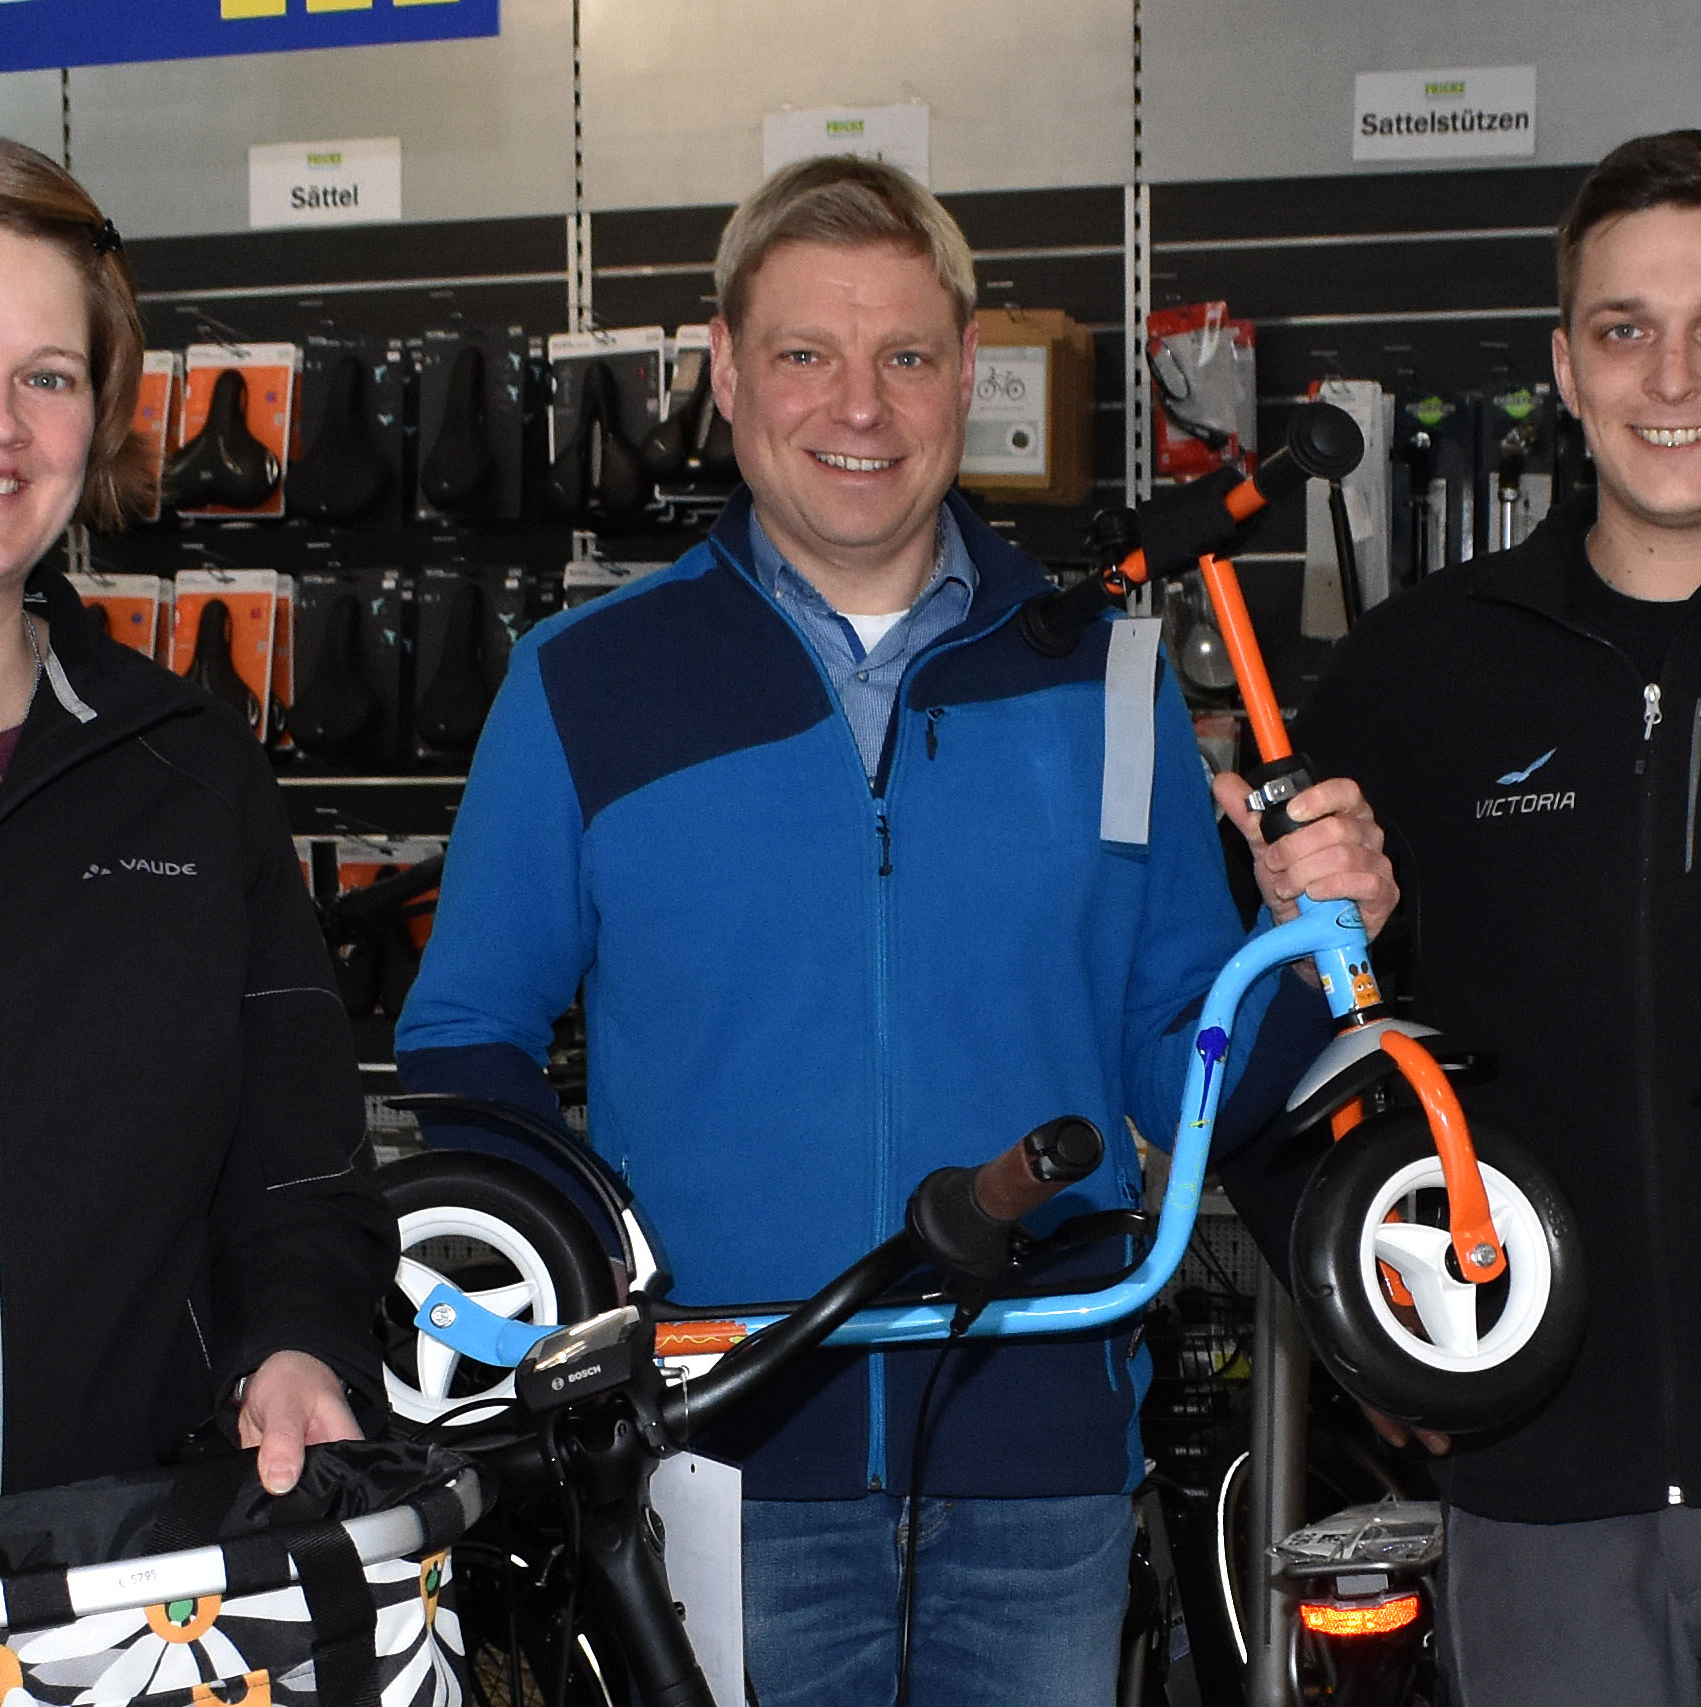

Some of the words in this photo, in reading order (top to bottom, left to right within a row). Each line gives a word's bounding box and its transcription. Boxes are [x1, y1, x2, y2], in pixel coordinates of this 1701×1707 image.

[1361, 109, 1530, 135] Sattelstützen
[291, 184, 359, 209] Sättel
[1476, 791, 1577, 819] VICTORIA
[119, 858, 199, 878] VAUDE
[568, 1365, 602, 1384] BOSCH
